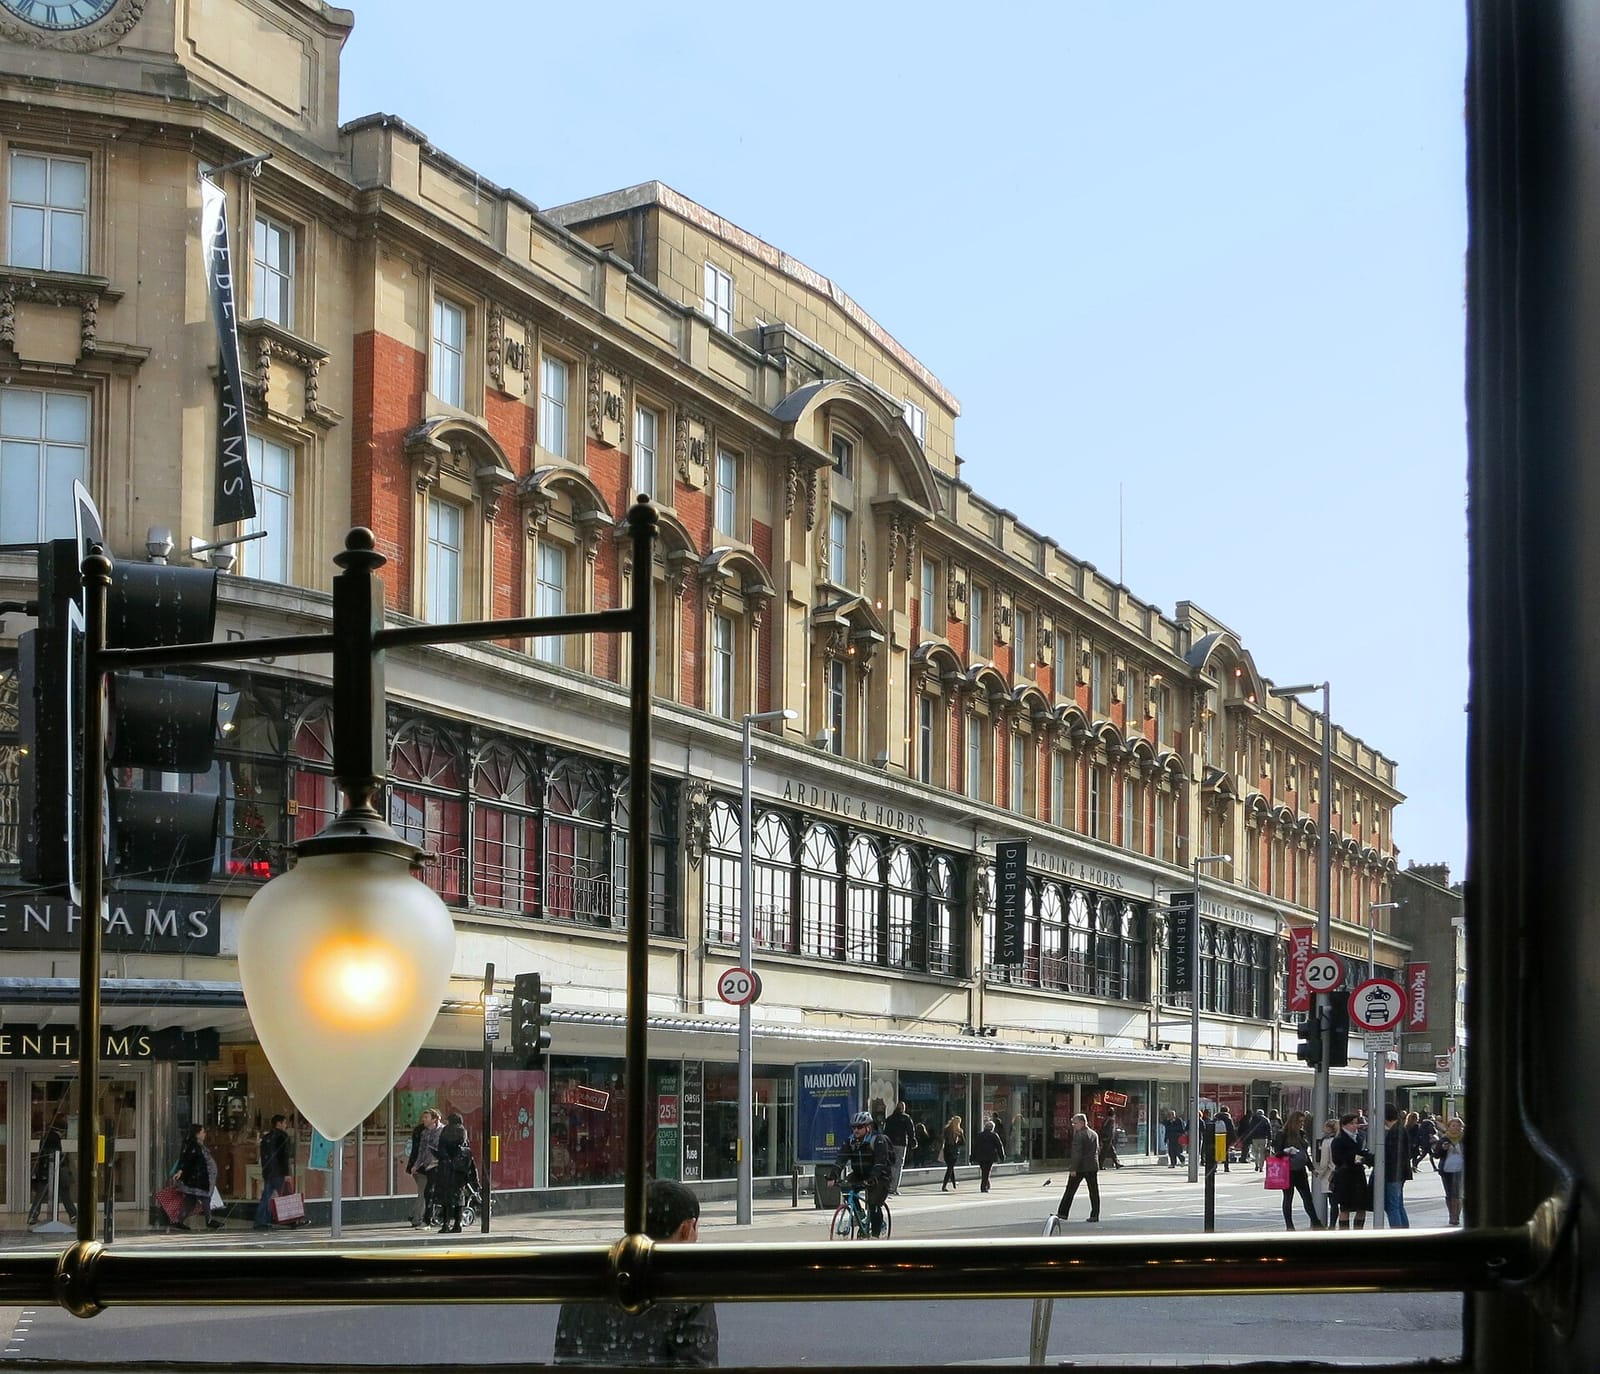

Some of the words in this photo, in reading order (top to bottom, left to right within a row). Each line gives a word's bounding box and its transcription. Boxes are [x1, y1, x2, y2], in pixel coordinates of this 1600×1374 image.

[783, 780, 852, 816] ARDING
[860, 801, 867, 821] &
[1032, 850, 1075, 877] ARDING
[1079, 864, 1085, 880] &
[1003, 849, 1017, 958] DEBENHAMS
[1176, 900, 1188, 985] DEBENHAMS
[1308, 965, 1336, 981] 20
[724, 979, 749, 995] 20
[0, 1034, 152, 1056] ENHMS
[804, 1072, 857, 1089] MANDOWN
